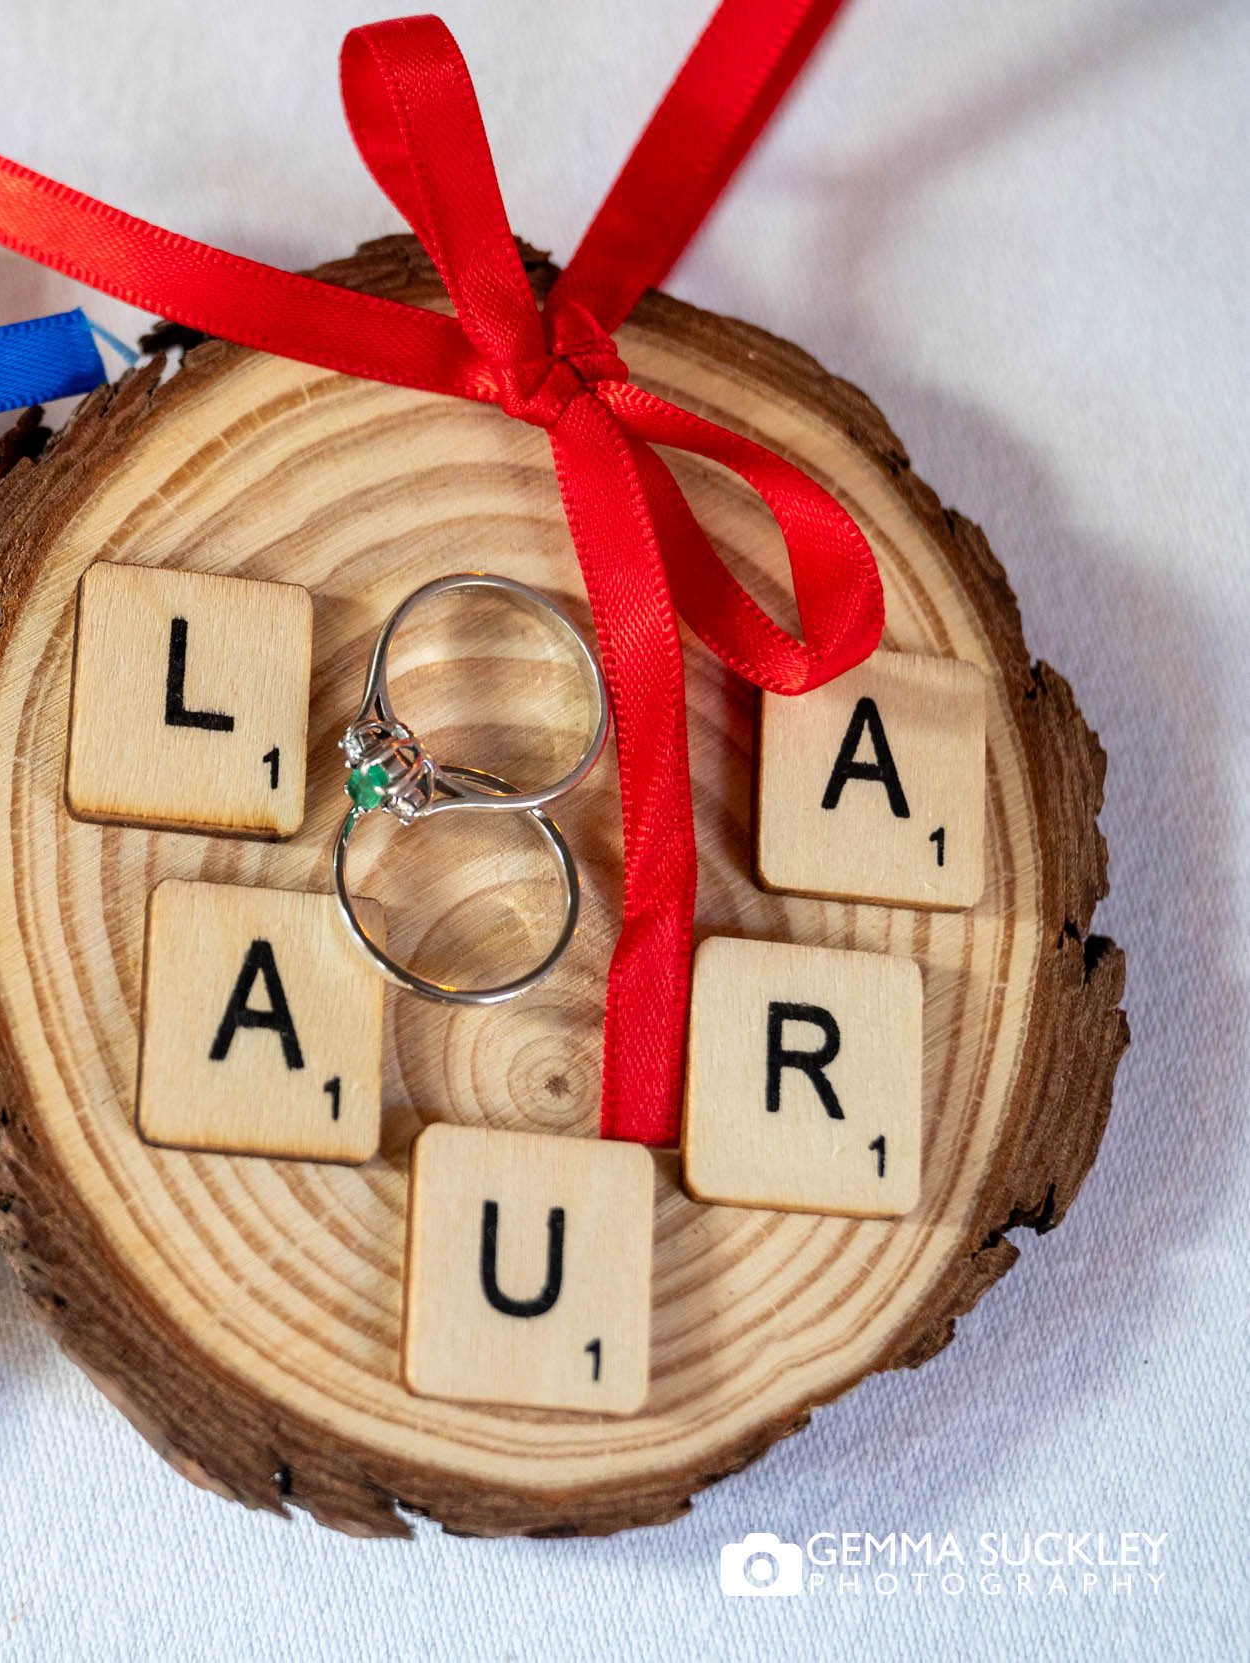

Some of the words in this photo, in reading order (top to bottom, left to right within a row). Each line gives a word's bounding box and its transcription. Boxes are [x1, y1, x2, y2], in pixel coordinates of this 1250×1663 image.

[164, 616, 235, 733] L
[262, 746, 280, 790] 1
[821, 696, 911, 819] A
[929, 827, 945, 867] 1
[208, 938, 305, 1071] A
[323, 1077, 341, 1121] 1
[766, 1001, 845, 1121] R
[869, 1135, 886, 1178] 1
[480, 1199, 565, 1319] U
[584, 1339, 601, 1382] 1
